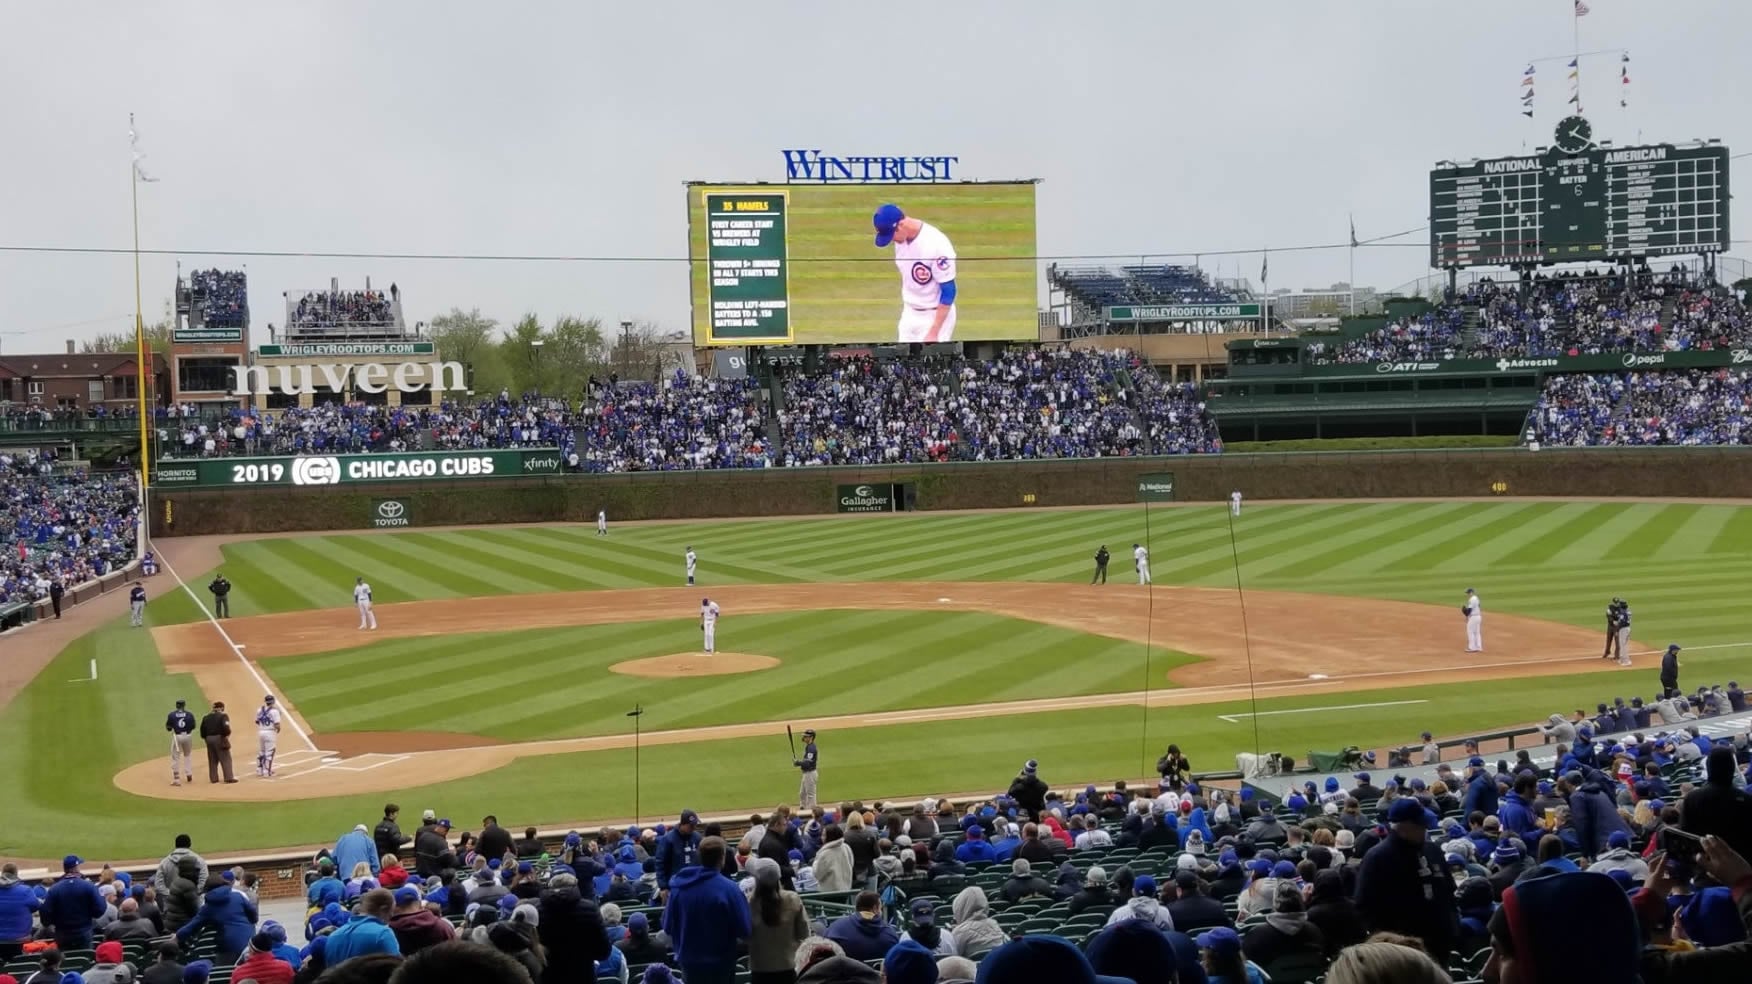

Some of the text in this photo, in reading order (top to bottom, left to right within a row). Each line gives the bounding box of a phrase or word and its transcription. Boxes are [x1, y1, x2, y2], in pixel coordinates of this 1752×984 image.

[1604, 148, 1667, 164] AMERICAN
[782, 149, 958, 180] WINTRUST
[1484, 158, 1543, 174] NATIONAL
[1559, 175, 1587, 185] BATTER
[1574, 184, 1583, 196] 6
[736, 201, 769, 211] HAMELS
[754, 220, 774, 229] START
[751, 229, 760, 238] AT
[712, 238, 760, 247] WRIGLEY FIELD
[713, 269, 779, 277] IN ALL 7 STARTS THIS
[713, 278, 739, 286] SEASON
[714, 301, 744, 309] HOLDING
[714, 310, 741, 318] BATTERS
[742, 310, 751, 318] TO
[752, 310, 758, 318] A
[715, 318, 759, 327] BATTING AVG.
[1510, 358, 1558, 368] Advocate
[1637, 353, 1665, 365] pepsi
[1392, 362, 1418, 372] ATI
[231, 360, 469, 395] nuveen
[523, 456, 560, 472] xfinity
[157, 469, 197, 478] HORNITOS
[232, 456, 495, 483] 2019 CHICAGO CUBS
[1146, 482, 1172, 491] National
[841, 495, 888, 507] Gallagher
[375, 518, 408, 526] TOYOTA
[178, 717, 186, 728] 6
